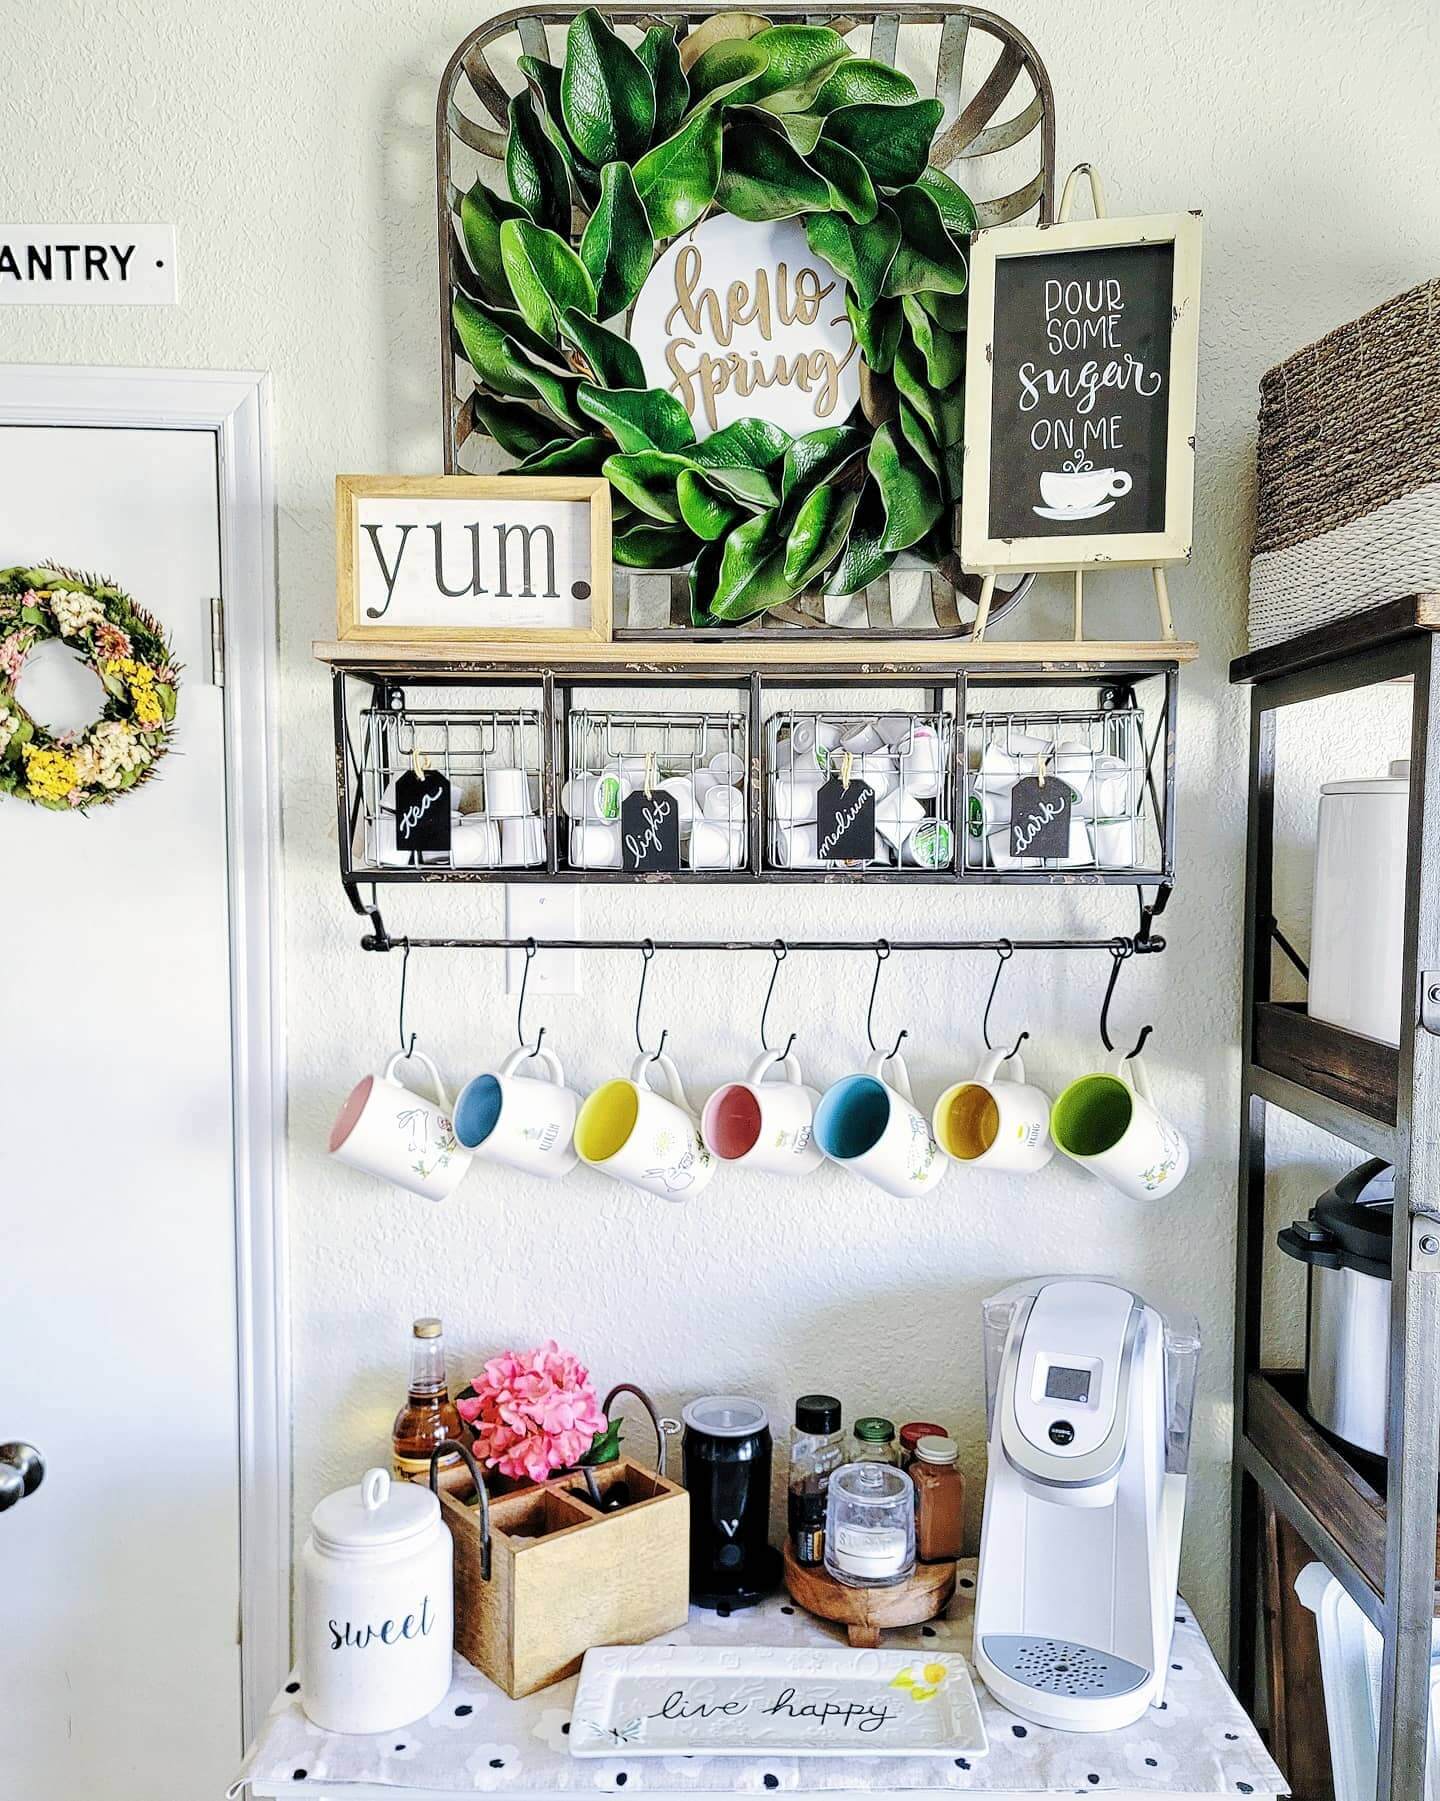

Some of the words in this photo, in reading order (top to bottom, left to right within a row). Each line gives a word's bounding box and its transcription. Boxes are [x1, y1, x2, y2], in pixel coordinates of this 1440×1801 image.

[0, 245, 136, 281] ANTRY
[665, 245, 836, 346] hello
[1045, 279, 1124, 320] POUR
[1047, 314, 1122, 355] SOME
[1030, 417, 1075, 450] ON
[1083, 416, 1124, 450] ME
[360, 521, 592, 619] yum.
[399, 786, 444, 840] tea
[624, 798, 671, 869] light
[817, 786, 875, 859] medium
[1014, 796, 1066, 855] dark
[328, 1594, 436, 1651] sweet
[647, 1690, 750, 1720] live
[761, 1687, 899, 1732] happy
